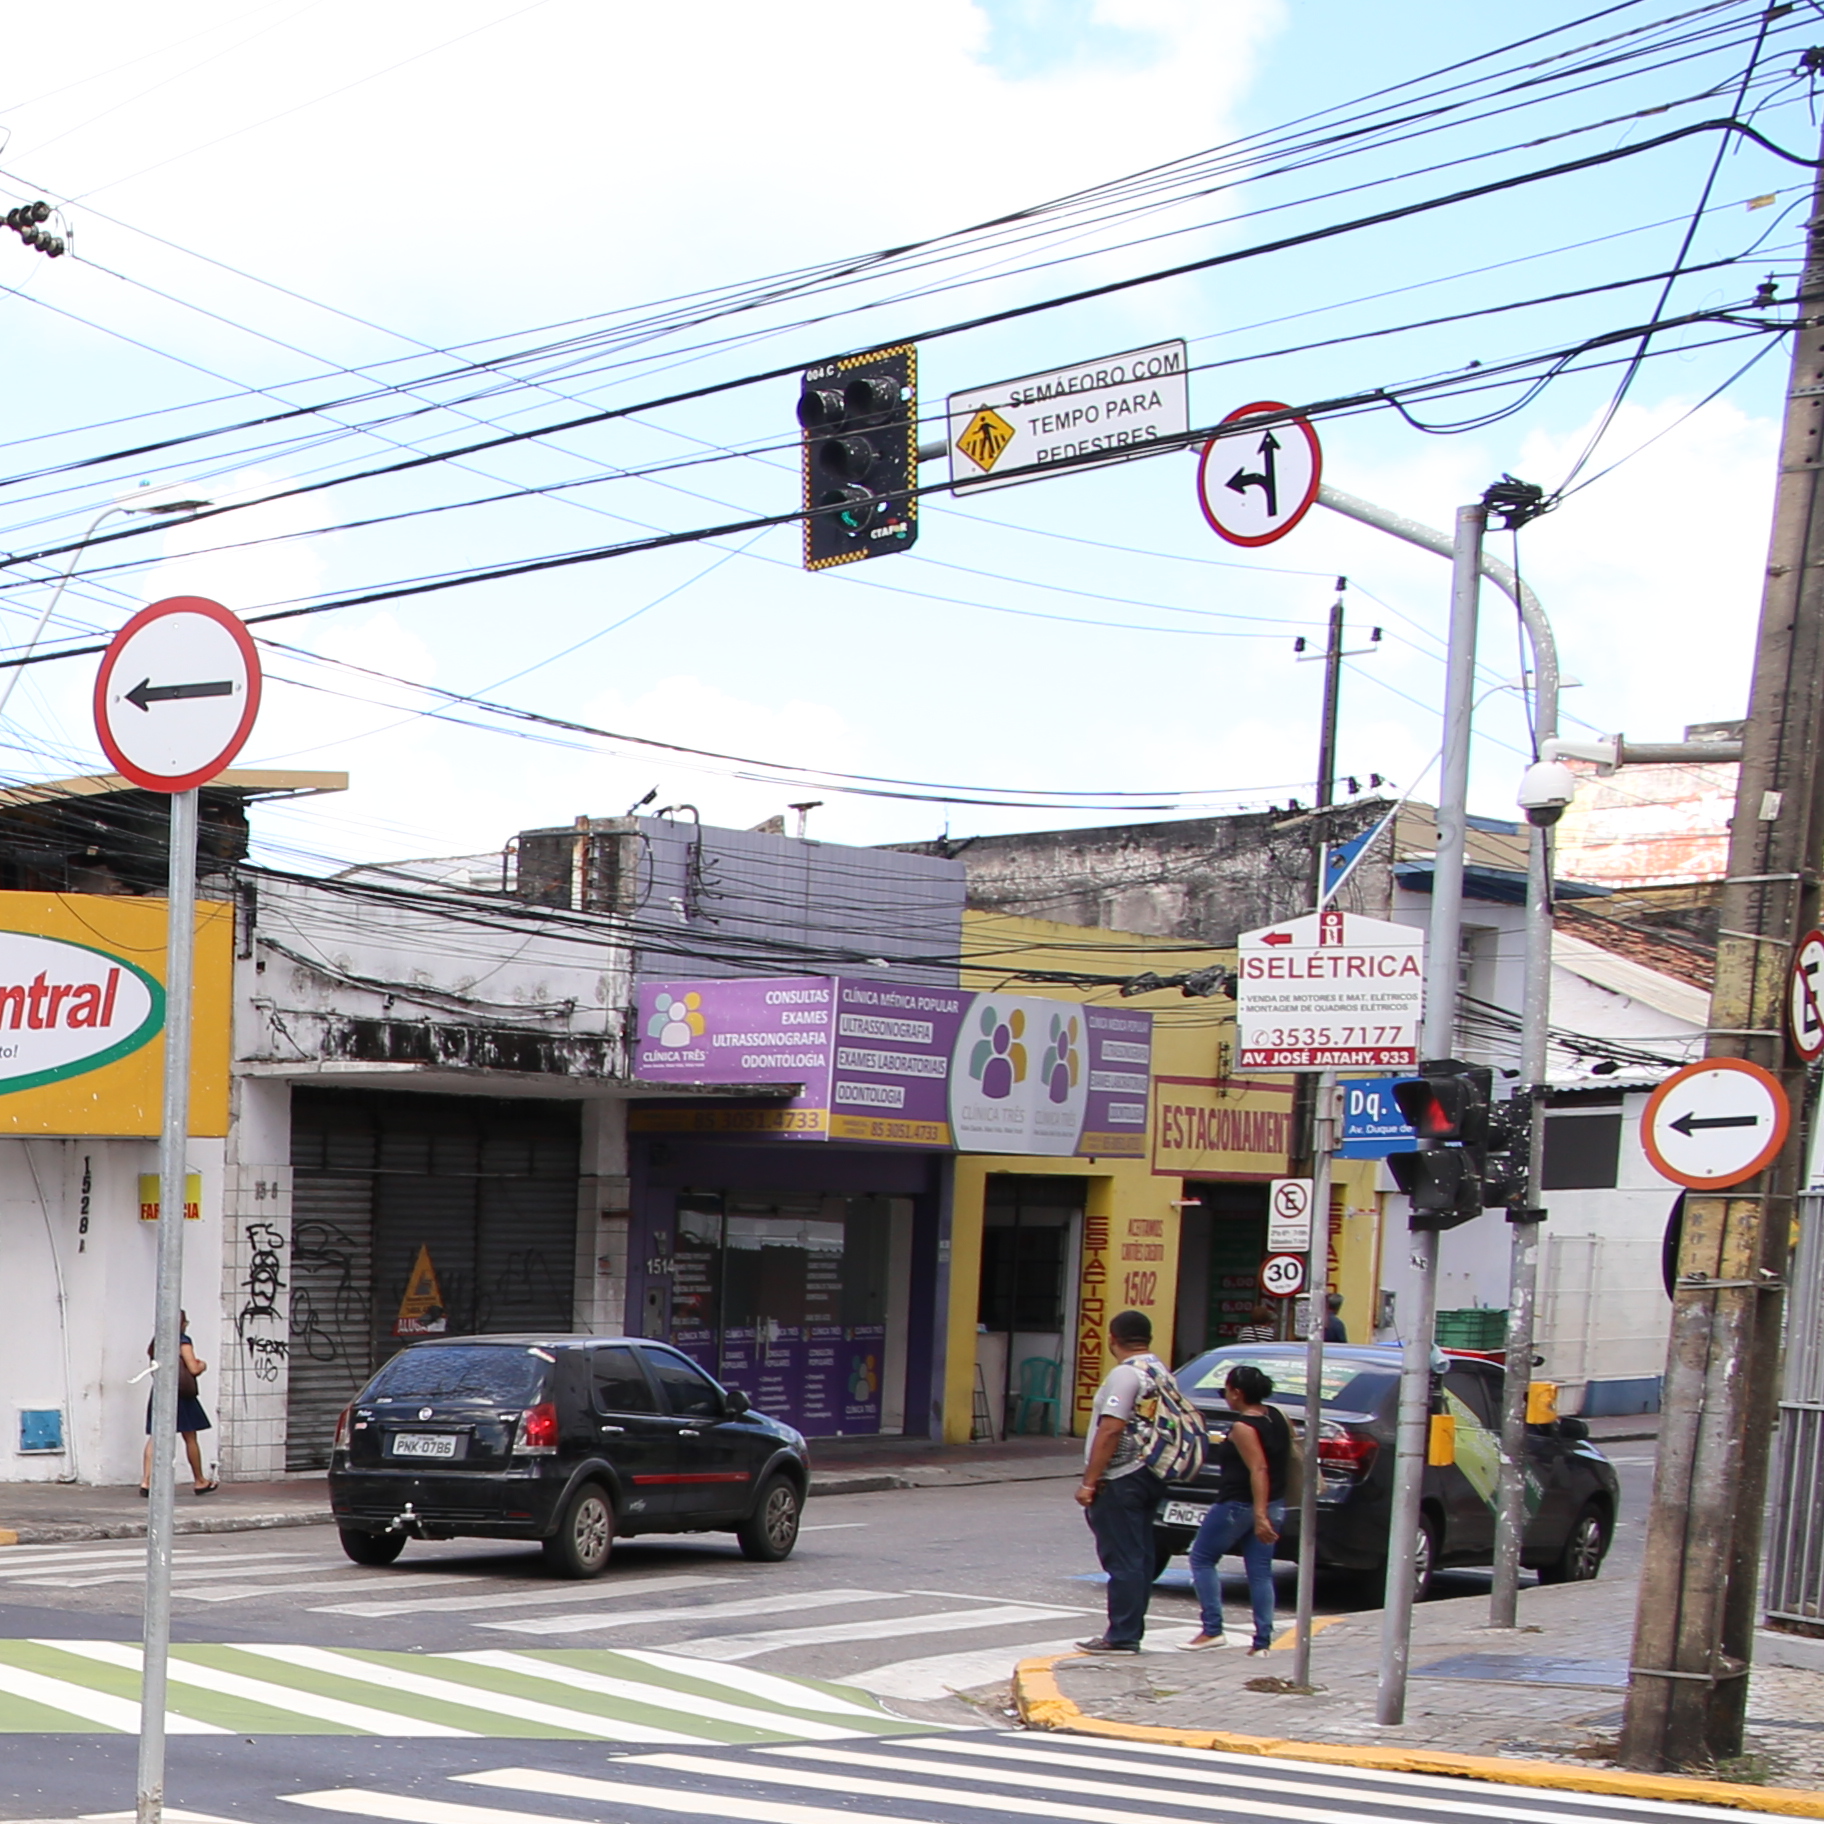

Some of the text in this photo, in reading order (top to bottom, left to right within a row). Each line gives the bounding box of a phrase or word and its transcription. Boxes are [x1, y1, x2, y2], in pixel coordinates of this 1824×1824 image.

[807, 365, 834, 381] 004 C
[1009, 353, 1181, 406] SEMÁFORO COM
[1028, 390, 1162, 437] TEMPO PARA
[1036, 426, 1158, 464] PEDESTRES
[1239, 951, 1421, 979] ISELÉTRICA
[766, 990, 829, 1005] CONSULTAS
[842, 988, 959, 1014] CLÍNICA MÉDICA POPULAR
[1247, 994, 1277, 1003] VENDA
[1279, 994, 1291, 1002] DE
[1293, 994, 1336, 1002] MOTORES
[1346, 993, 1368, 1002] MAT.
[1371, 992, 1418, 1001] ELÉTRICOS
[1246, 1003, 1408, 1013] MONTAGEM DE QUADROS ELÉTRICOS
[782, 1011, 828, 1026] EXAMES
[841, 1017, 931, 1040] ULTRASSONOGRAFIA
[1271, 1026, 1402, 1047] 3535.7177
[712, 1032, 827, 1048] ULTRASSONOGRAFIA
[643, 1049, 705, 1063] CLÍNICA TRÊS
[838, 1050, 946, 1075] EXAMES LABORATORIAIS
[1242, 1049, 1410, 1066] AV. JOSÉ JATAHY, 933
[838, 1085, 902, 1104] ODONTOLOGIA
[961, 1103, 1025, 1123] CLÍNICA TRÊS
[1351, 1089, 1387, 1121] Dq.
[722, 1112, 820, 1131] 3051.4733
[871, 1121, 885, 1137] 85
[887, 1123, 938, 1141] 3051.4733
[1349, 1125, 1412, 1134] Av. Duque de
[1128, 1218, 1164, 1237] ACEITAMOS
[647, 1259, 674, 1274] 1514
[1268, 1262, 1298, 1281] 30
[1123, 1272, 1157, 1306] 1502
[1077, 1216, 1109, 1412] ESTACIONAMENTO
